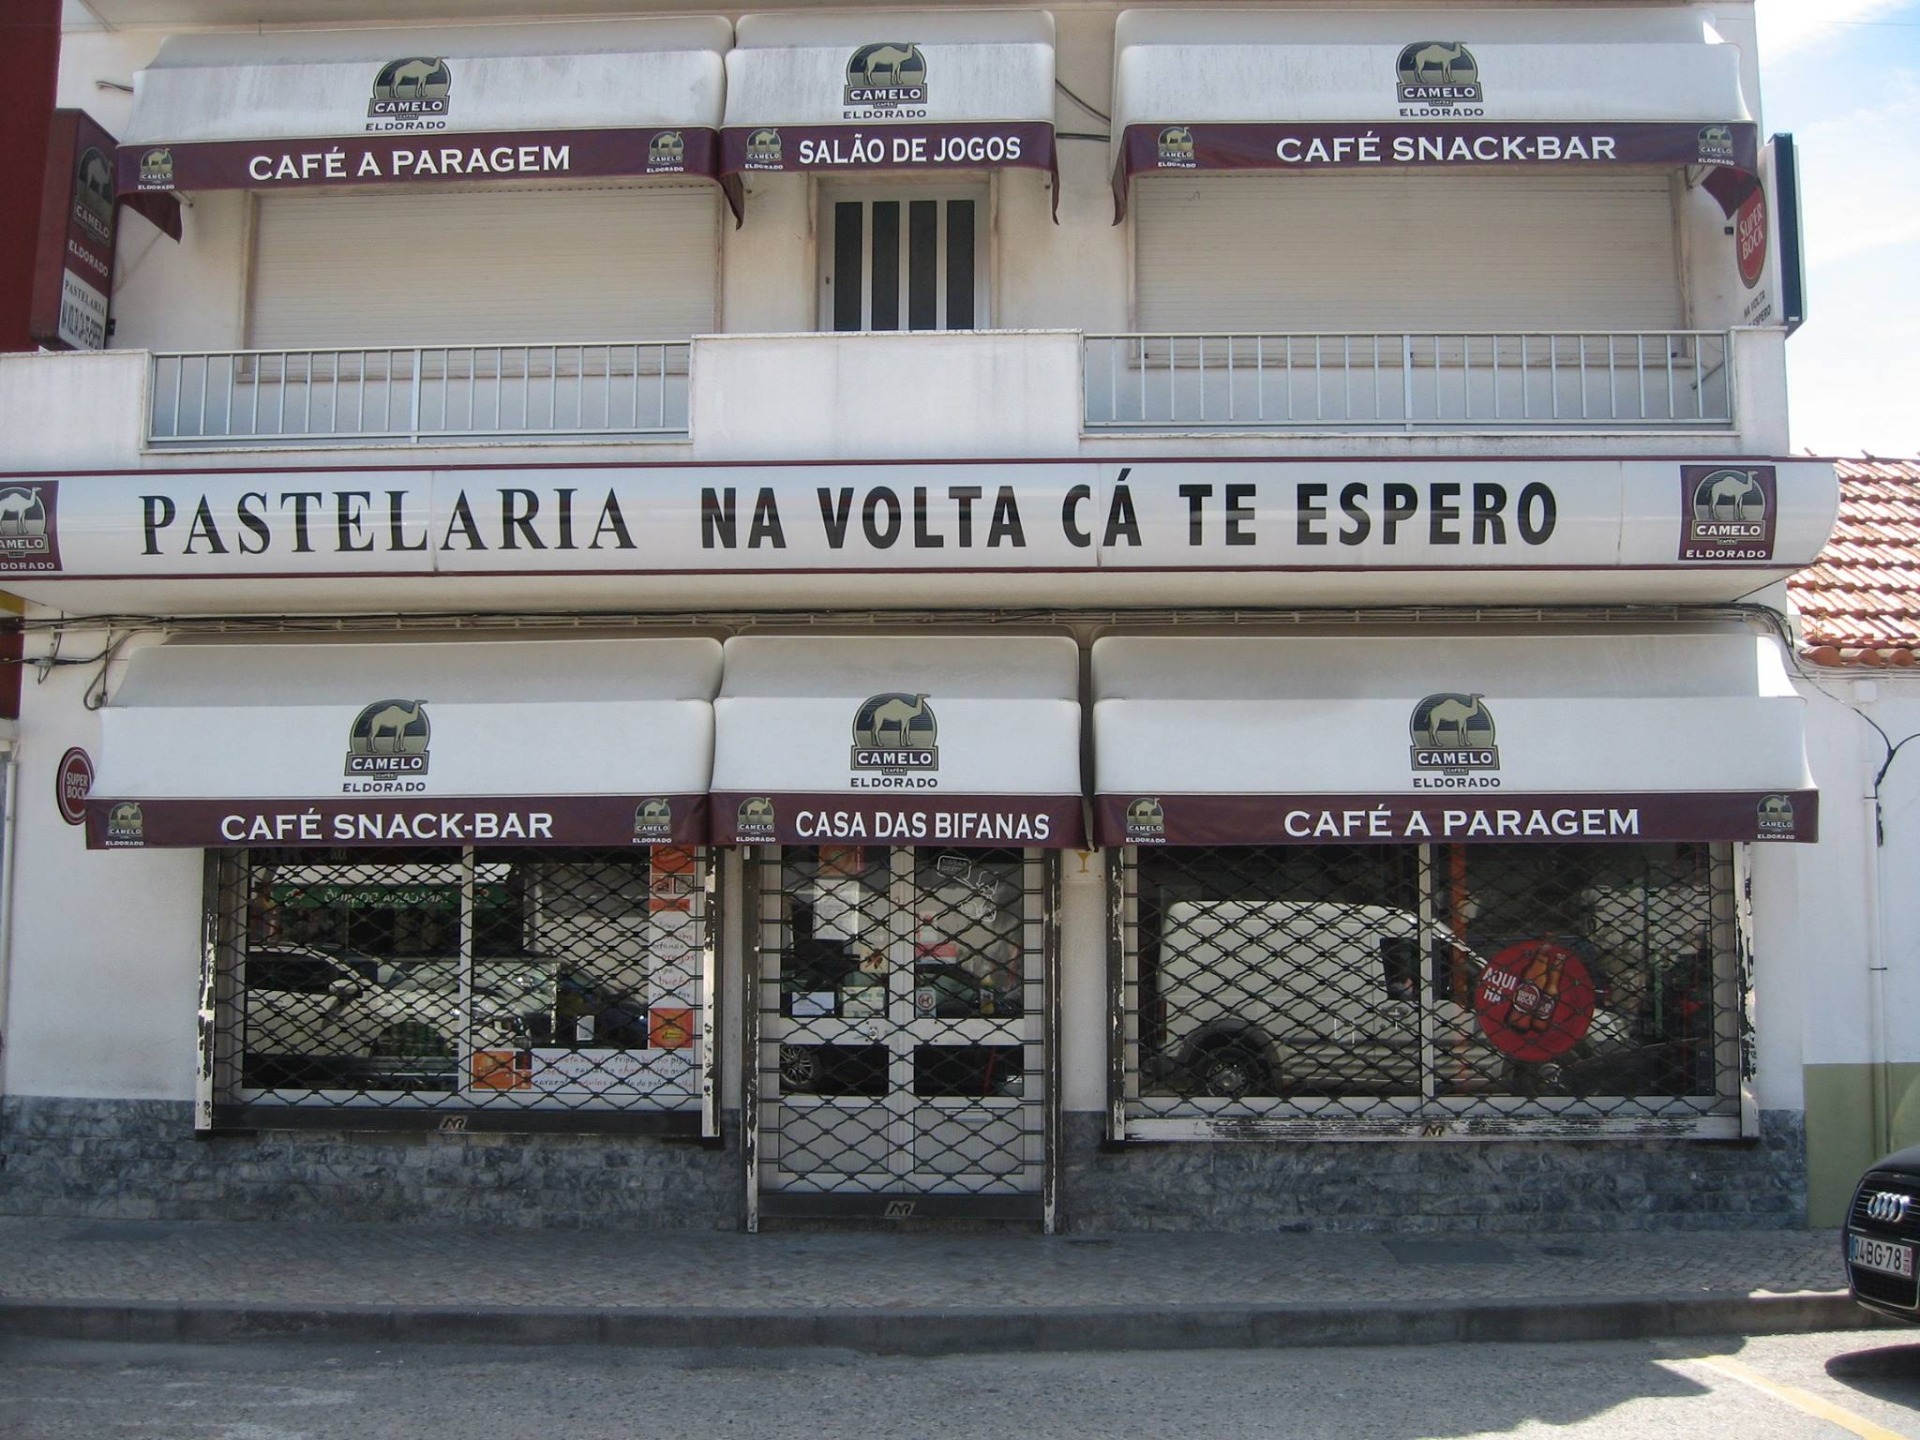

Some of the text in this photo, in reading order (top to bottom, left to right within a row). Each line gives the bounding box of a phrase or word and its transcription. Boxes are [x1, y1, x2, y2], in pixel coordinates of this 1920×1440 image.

[850, 89, 922, 101] CAMELO
[1404, 88, 1476, 98] CAMELO
[374, 101, 443, 114] CAMELO
[1400, 108, 1485, 118] ELDORADO
[843, 109, 928, 120] ELDORADO
[365, 121, 446, 132] ELDORADO
[799, 134, 1022, 165] SALÃO DE JOGOS
[1276, 131, 1617, 163] CAFÉ SNACK-BAR
[248, 145, 571, 181] CAFÉ A PARAGEM
[1697, 158, 1734, 166] ELDORADO
[75, 206, 111, 240] CAMELO
[1739, 203, 1763, 242] SUPER
[1741, 229, 1765, 260] BOCK
[68, 239, 109, 277] ELDORADO
[65, 279, 105, 317] PASTELARIA
[138, 467, 1557, 556] PASTELARIA NA VOLTA CÁ TE ESPERO
[1696, 525, 1761, 536] CAMELO
[1685, 549, 1767, 559] ELDORADO
[0, 562, 55, 570] DORADO
[352, 757, 423, 770] CAMELO
[858, 752, 932, 765] CAMELO
[1417, 752, 1493, 764] CAMELO
[66, 771, 89, 787] SUPER
[850, 778, 938, 789] ELDORADO
[1412, 778, 1501, 789] ELDORADO
[66, 786, 87, 799] BOCK
[342, 782, 427, 793] ELDORADO
[220, 806, 554, 840] CAFÉ SNACK-BAR
[795, 810, 1050, 840] CASA DAS BIFANAS
[1283, 803, 1640, 837] CAFÉ A PARAGEM
[1482, 967, 1517, 991] AQUI
